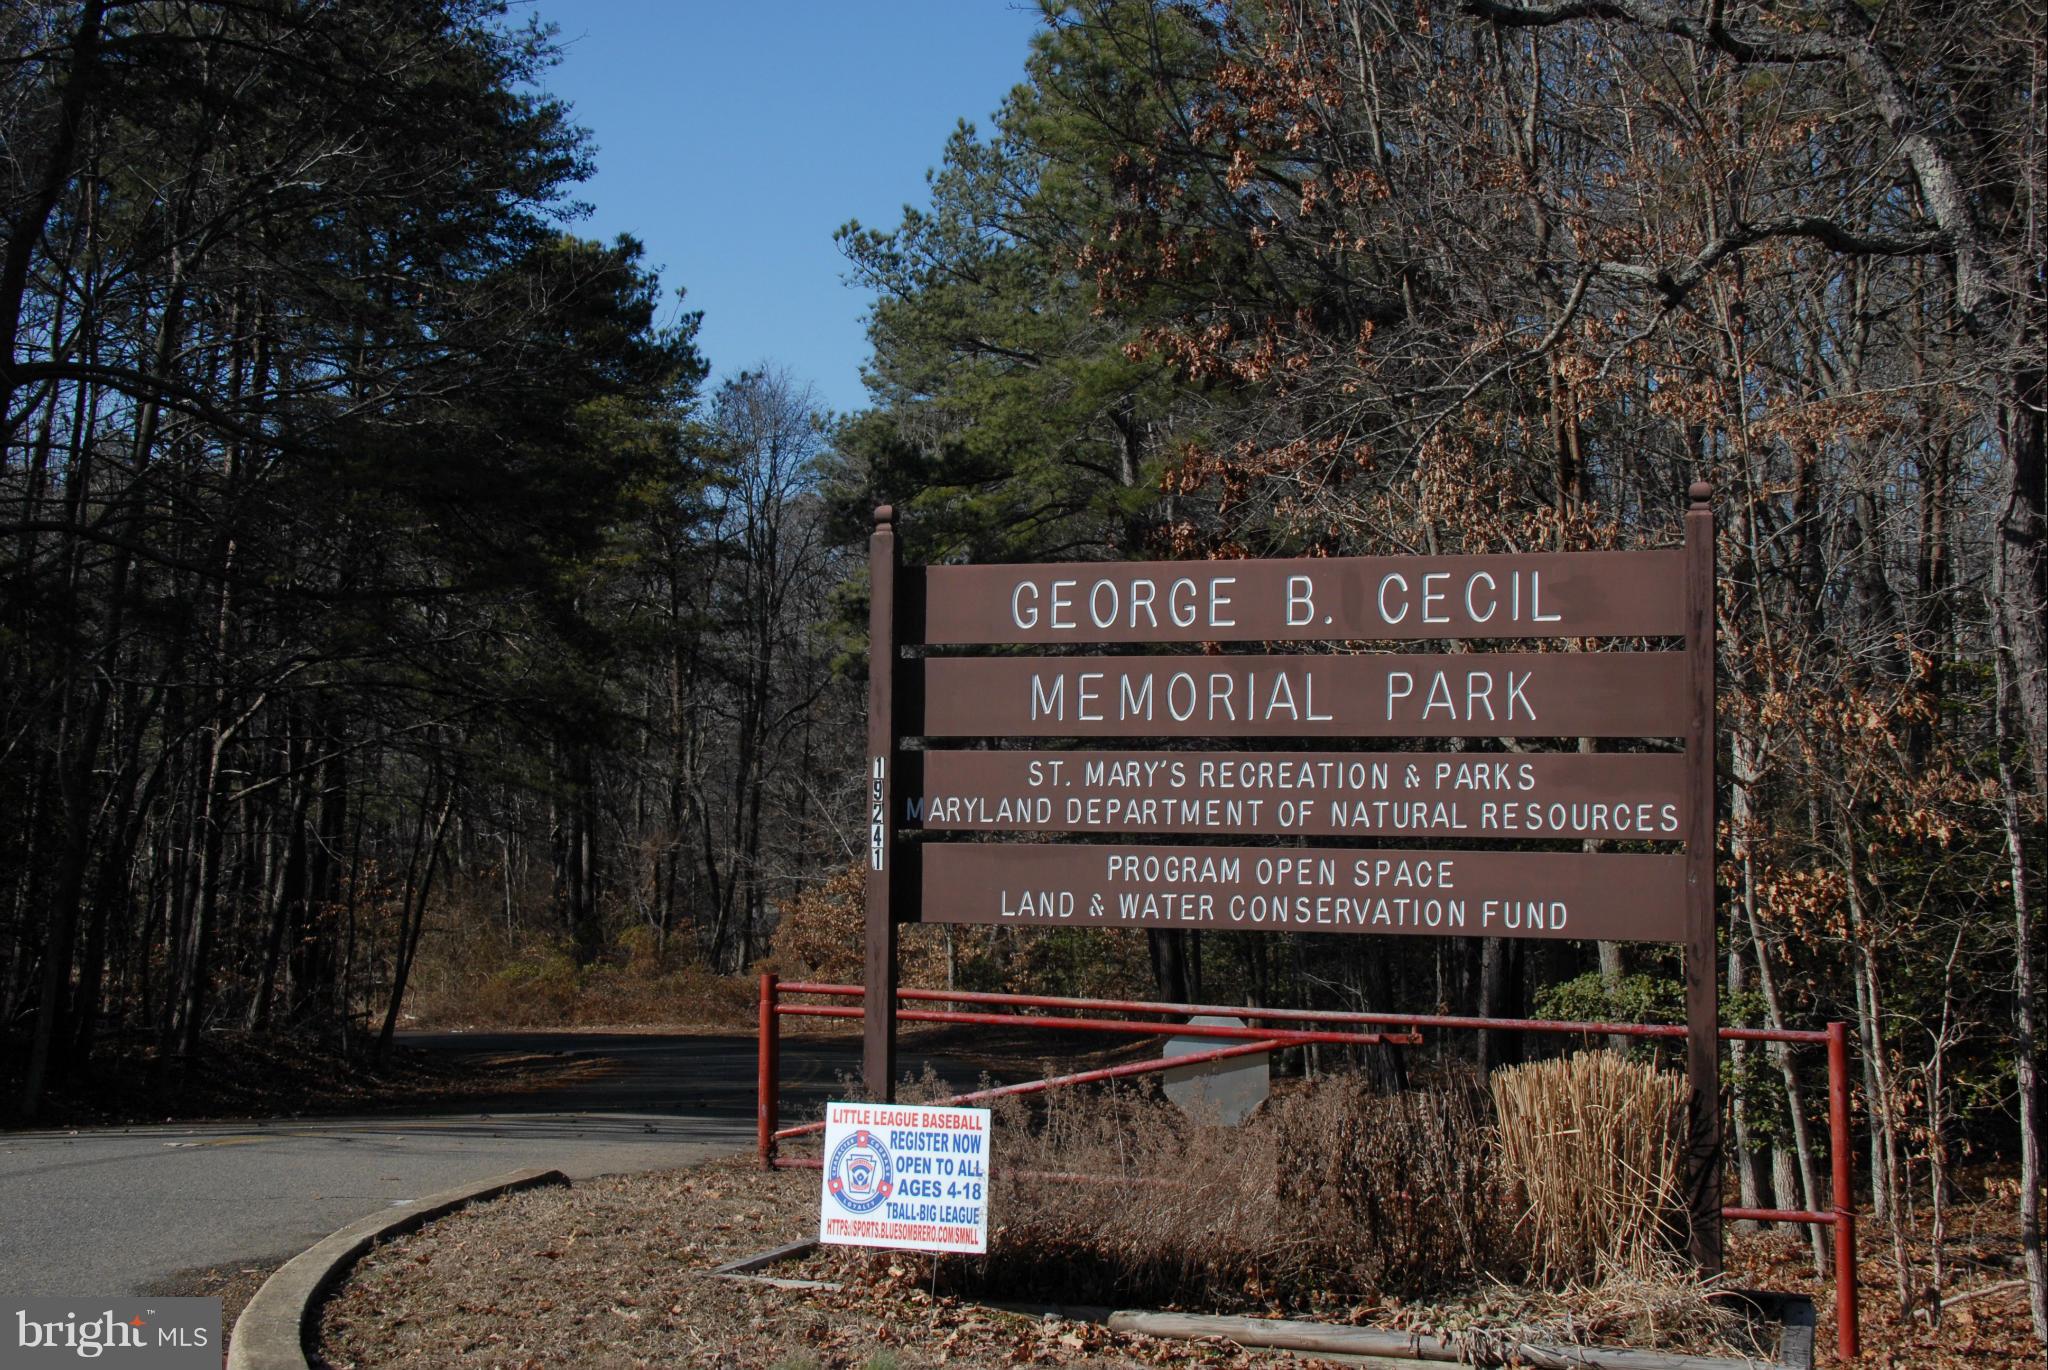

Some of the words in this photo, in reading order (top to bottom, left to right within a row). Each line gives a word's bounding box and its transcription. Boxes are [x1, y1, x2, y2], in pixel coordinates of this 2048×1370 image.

[1011, 577, 1237, 630] GEORGE
[1286, 575, 1333, 626] B.
[1377, 571, 1562, 625] CECIL
[1031, 671, 1334, 722] MEMORIAL
[1387, 670, 1537, 721] PARK
[1028, 760, 1071, 788] ST.
[1085, 759, 1187, 788] MARY'S
[1199, 761, 1388, 790] RECREATION
[1404, 763, 1421, 790] &
[1435, 762, 1536, 791] PARKS
[872, 757, 884, 870] 19241
[906, 796, 1052, 824] MARYLAND
[1066, 797, 1264, 826] DEPARTMENT
[1278, 800, 1315, 828] OF
[1331, 800, 1468, 829] NATURAL
[1481, 802, 1679, 832] RESOURCES
[1107, 855, 1240, 884] PROGRAM
[1255, 857, 1335, 887] OPEN
[1353, 860, 1455, 889] SPACE
[1001, 890, 1075, 918] LAND
[1088, 892, 1105, 918] &
[1118, 893, 1214, 921] WATER
[1229, 894, 1465, 928] CONSERVATION
[1482, 900, 1568, 930] FUND
[833, 1109, 870, 1125] LITTLE
[874, 1110, 919, 1128] LEAGUE
[922, 1113, 982, 1131] BASEBALL
[890, 1130, 949, 1152] REGISTER
[952, 1134, 981, 1154] NOW
[896, 1156, 931, 1175] OPEN
[936, 1158, 954, 1176] TO
[958, 1159, 983, 1177] ALL
[898, 1179, 941, 1198] AGES
[947, 1182, 982, 1200] 4-18
[886, 1202, 936, 1222] TBALL-BIG
[939, 1205, 980, 1225] LEAGUE
